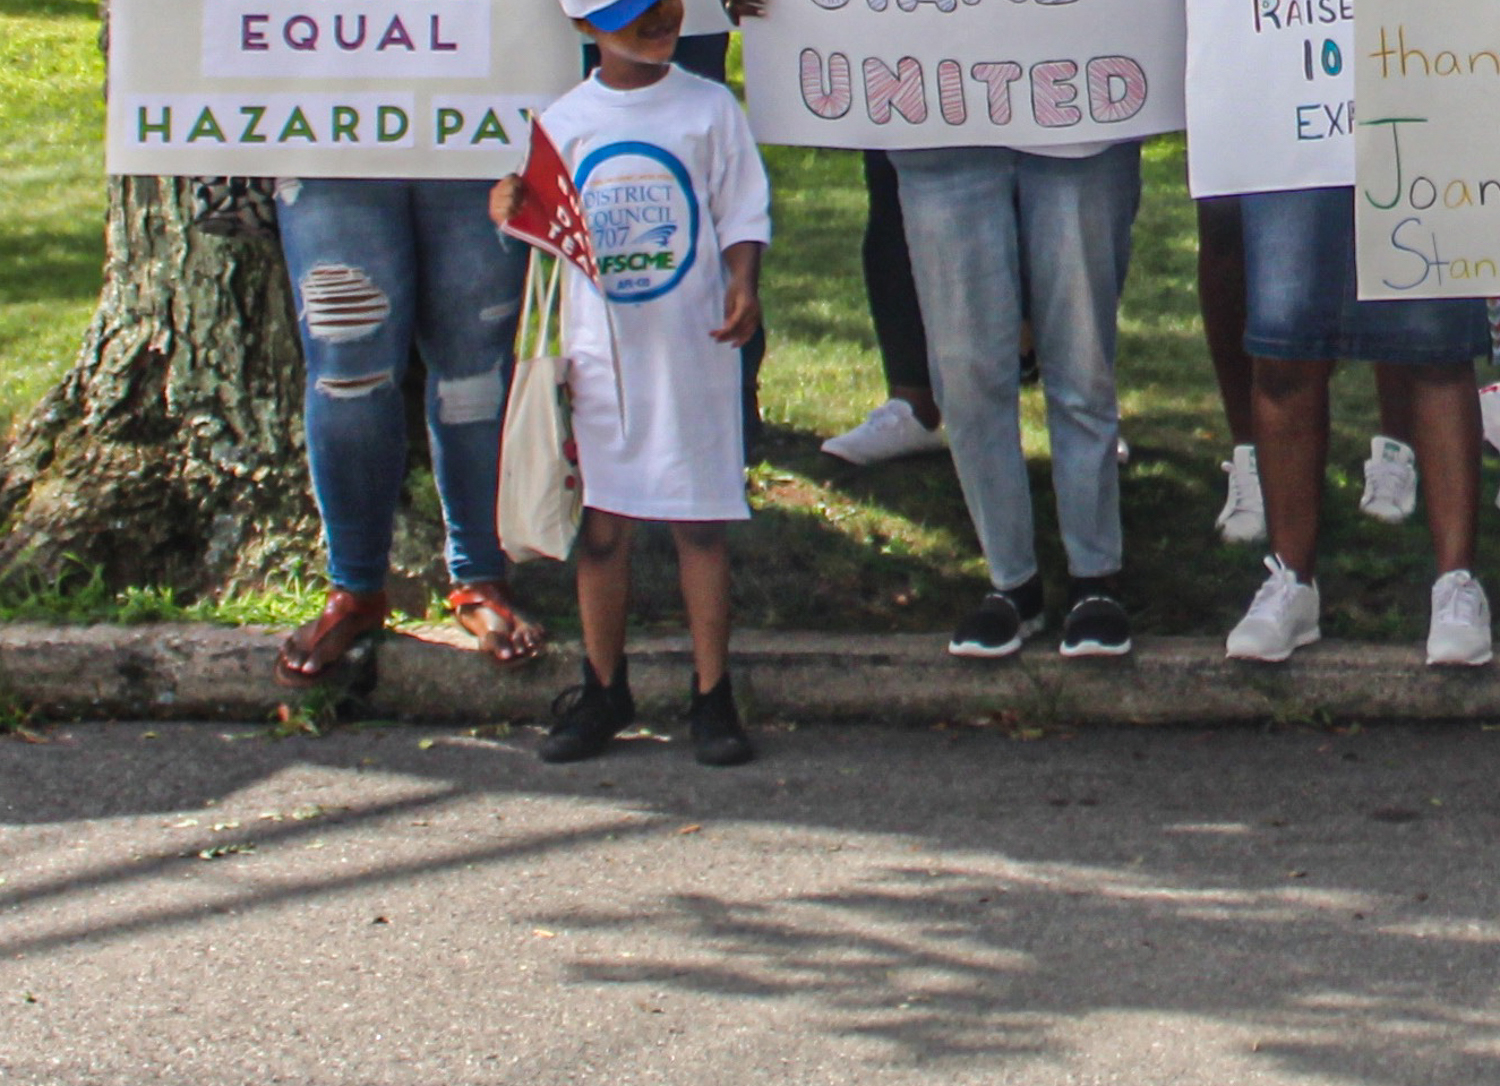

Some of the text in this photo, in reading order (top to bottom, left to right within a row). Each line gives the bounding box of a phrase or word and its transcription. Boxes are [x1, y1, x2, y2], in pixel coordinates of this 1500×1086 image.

[241, 13, 457, 51] EQUAL
[1304, 38, 1343, 81] 10
[799, 48, 1147, 126] UNITED
[138, 106, 409, 143] HAZARD
[584, 185, 672, 207] DISTRICT
[596, 225, 630, 248] 707
